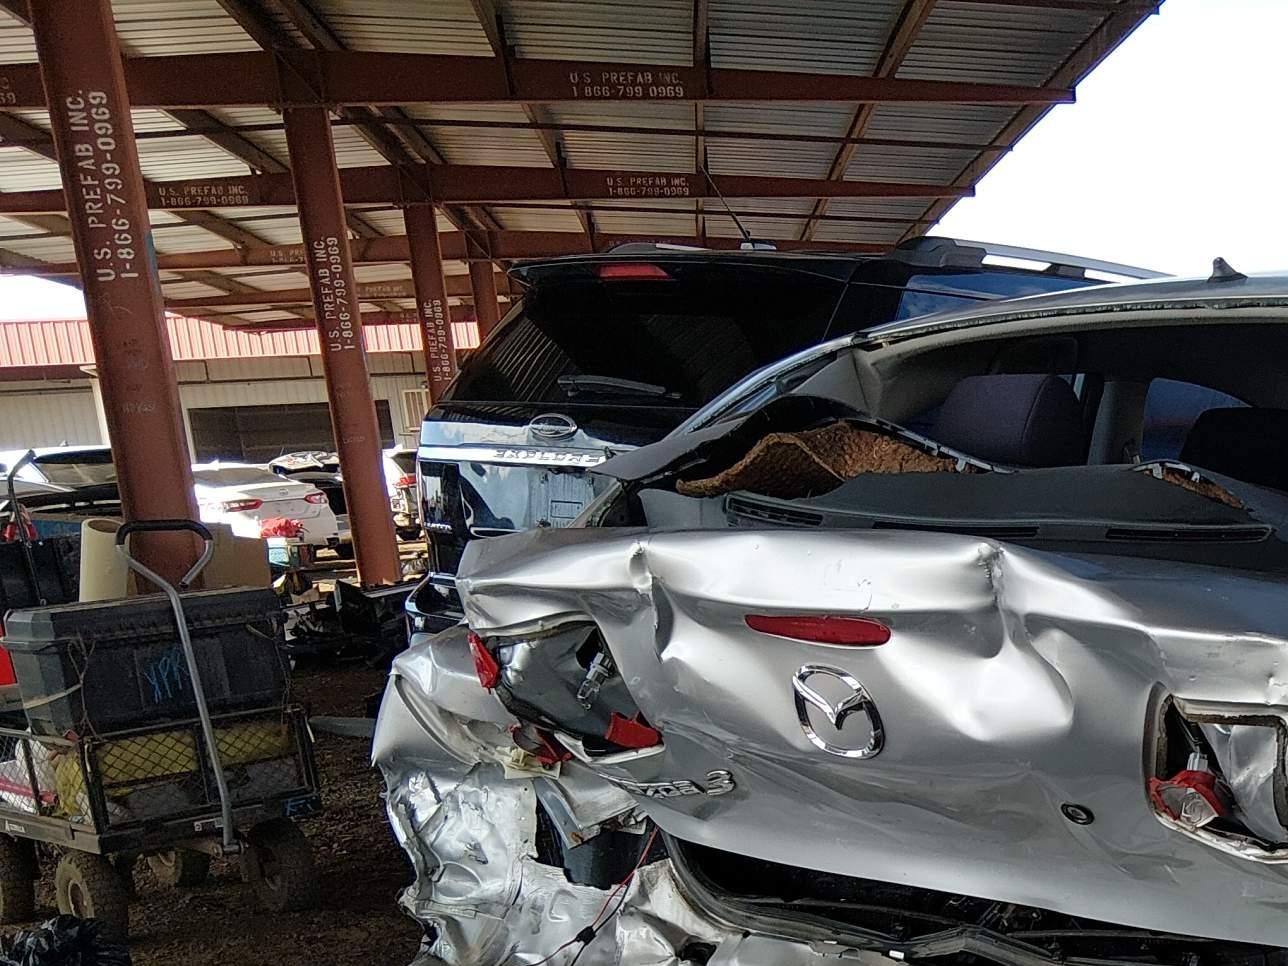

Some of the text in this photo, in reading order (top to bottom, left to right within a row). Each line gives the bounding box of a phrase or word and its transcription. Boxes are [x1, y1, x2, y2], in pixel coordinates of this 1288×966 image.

[601, 71, 653, 84] PREFAB
[65, 89, 117, 282] U.S. PREFAB INC.
[88, 91, 139, 279] 1-866-799-0969
[313, 237, 343, 352] U.S. PREFAB INC.
[326, 237, 356, 349] 1-866-799-0969
